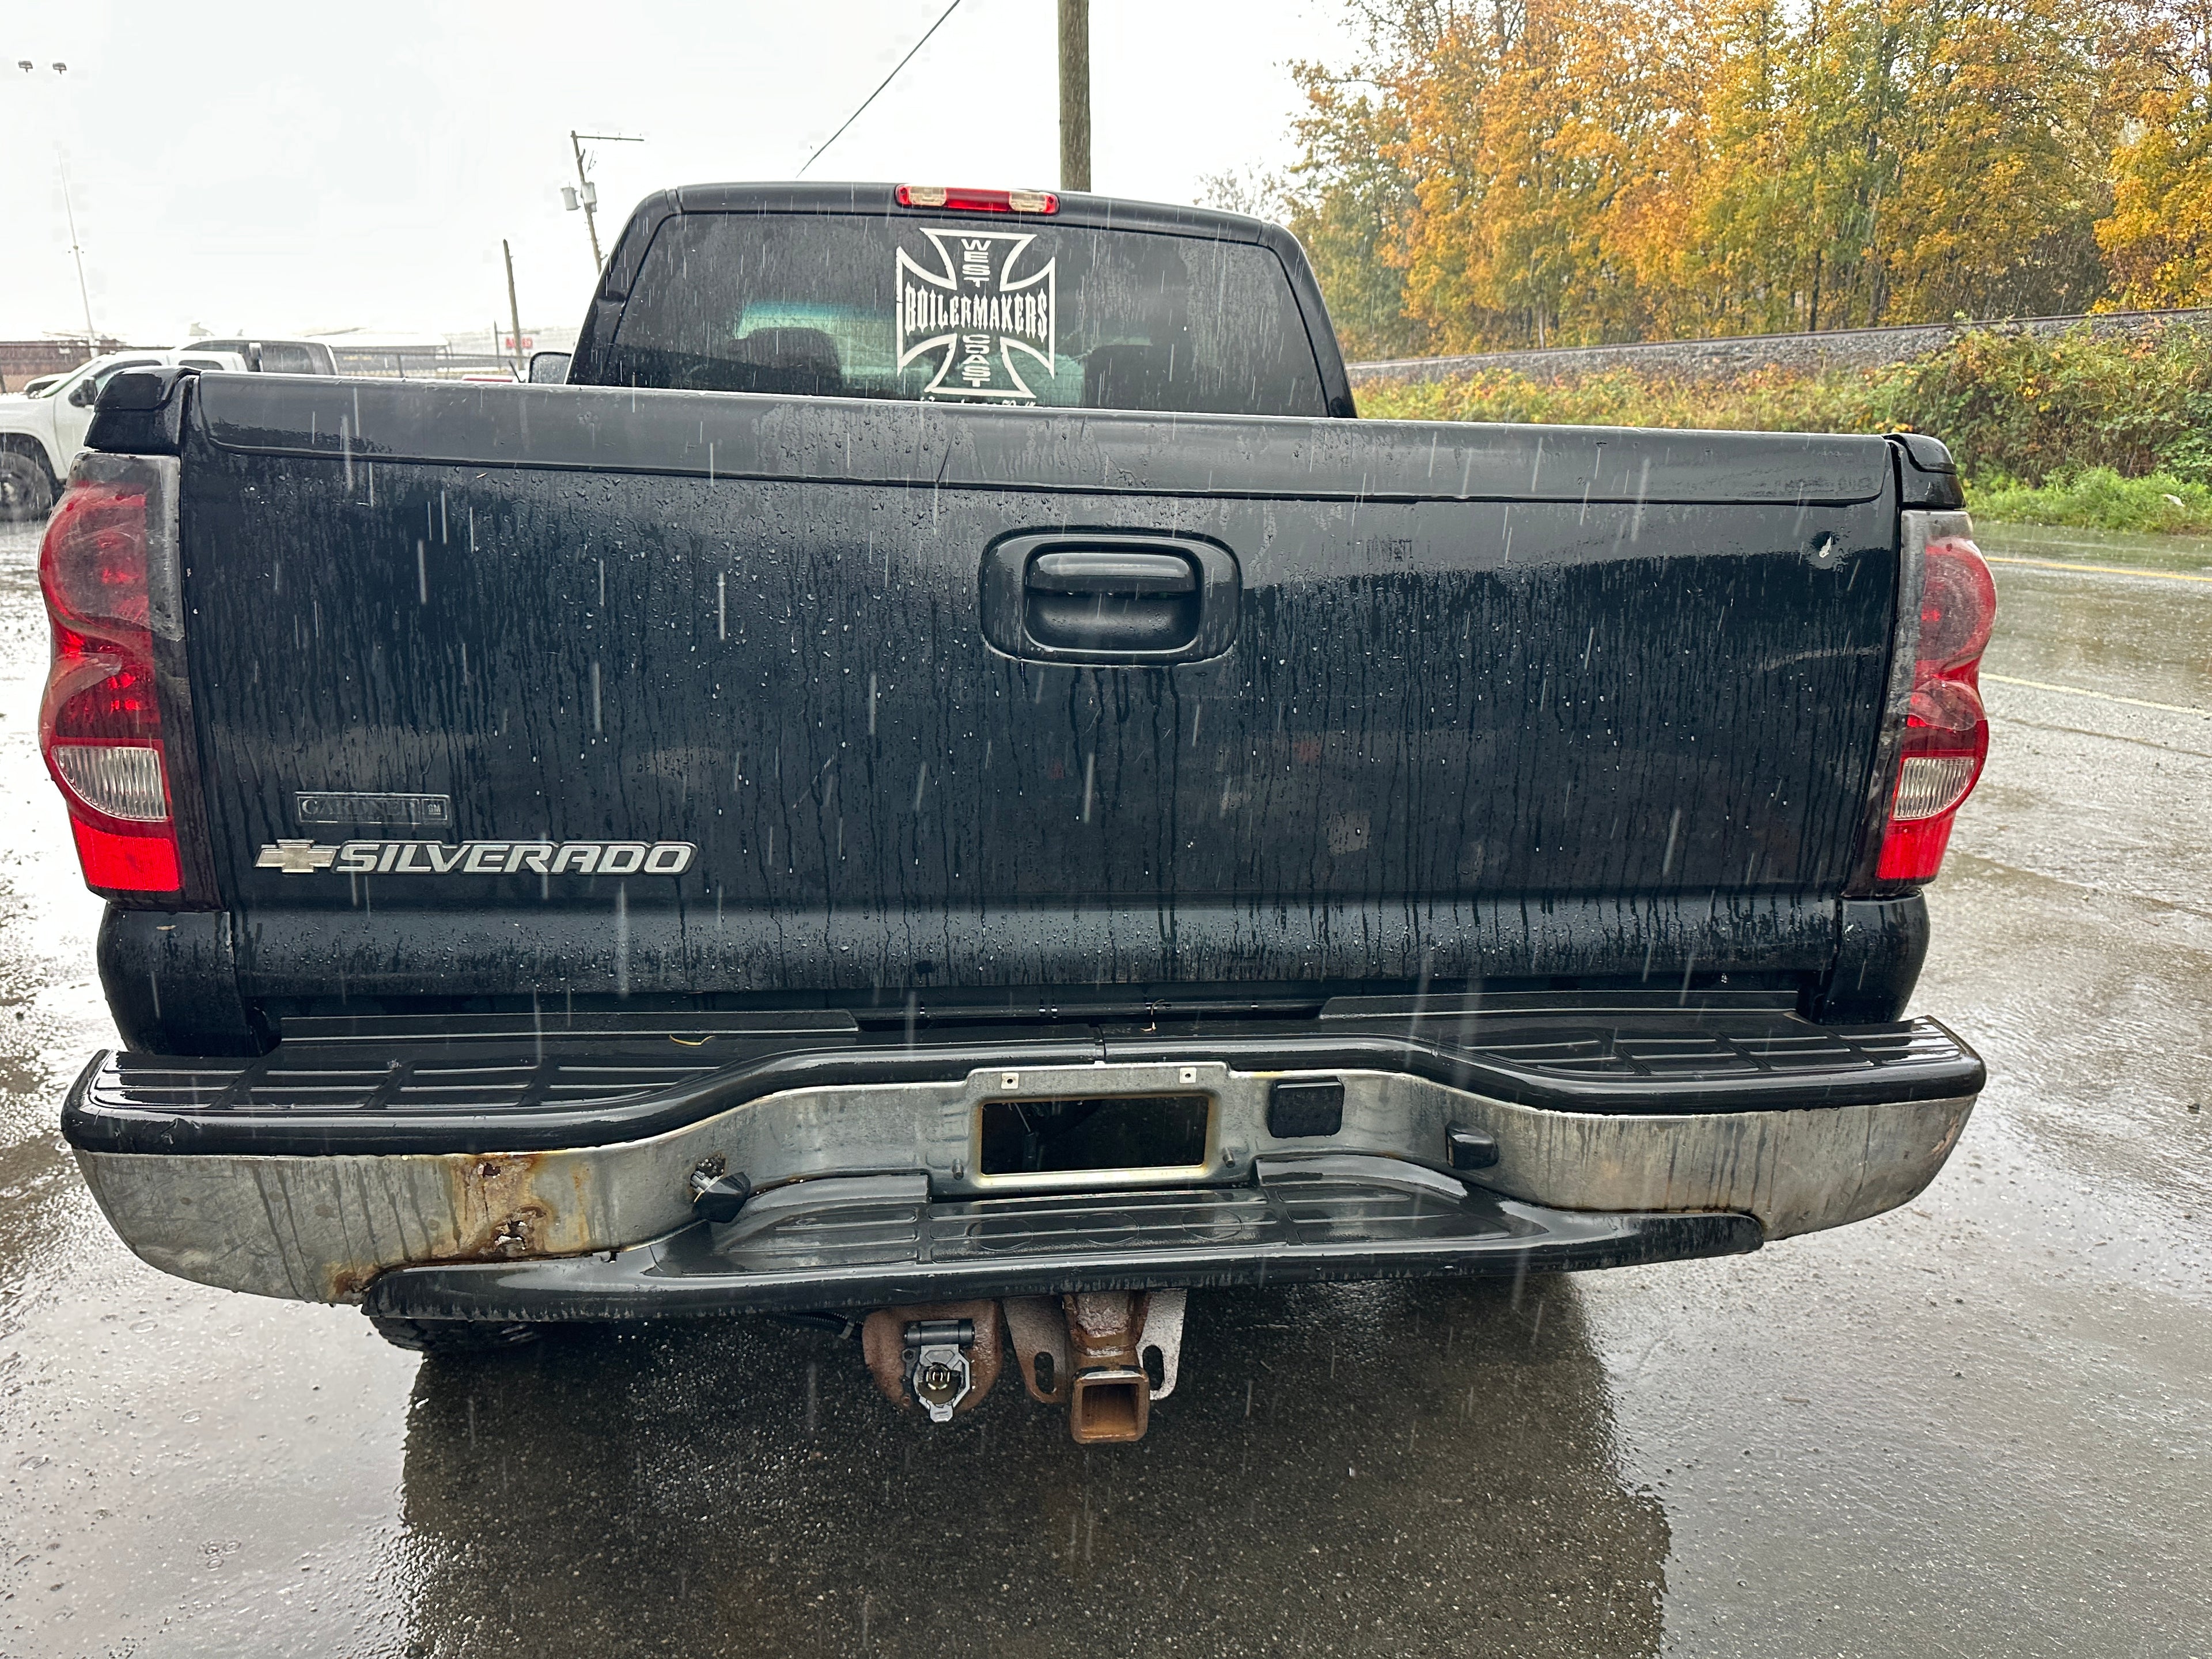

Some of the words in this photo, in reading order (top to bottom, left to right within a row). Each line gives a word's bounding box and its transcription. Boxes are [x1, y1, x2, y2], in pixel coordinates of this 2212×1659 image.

[961, 238, 991, 287] WEST
[904, 281, 1048, 343] BOILERMAKERS
[962, 334, 991, 387] COAST
[427, 804, 441, 813] GM
[336, 844, 692, 873] SILVERADO
